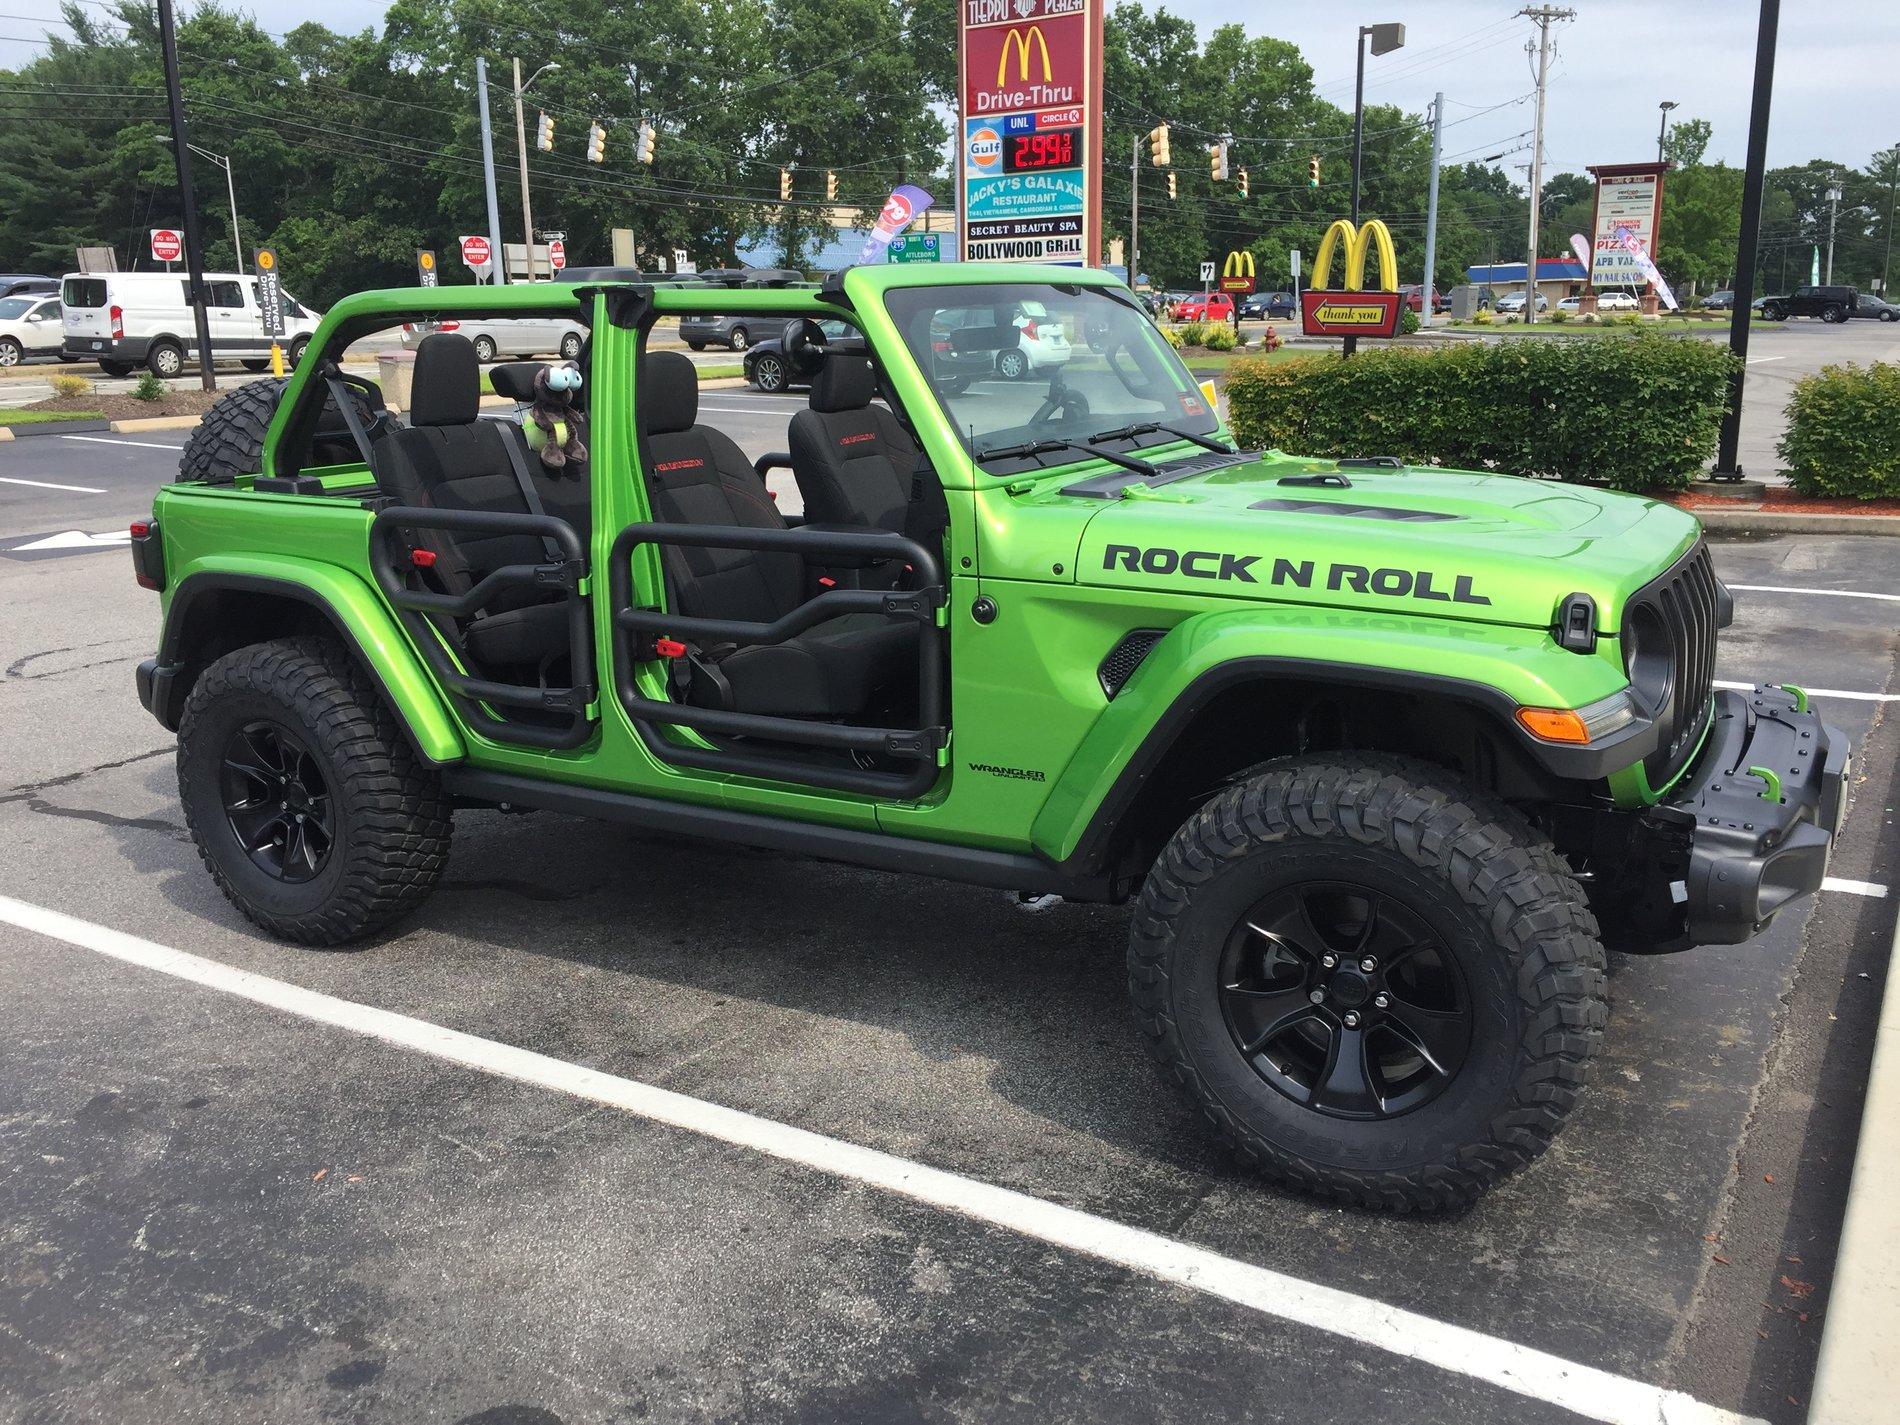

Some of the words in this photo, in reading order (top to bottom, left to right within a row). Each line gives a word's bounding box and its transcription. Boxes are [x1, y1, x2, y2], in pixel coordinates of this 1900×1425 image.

[977, 85, 1073, 111] Drive-Thru
[1010, 117, 1029, 129] UNL
[1041, 113, 1068, 123] CIRCLE
[1069, 110, 1079, 122] K
[970, 142, 1000, 154] Gulf
[968, 178, 1021, 208] JACKY'S
[1024, 176, 1083, 200] GALAXIE
[993, 193, 1057, 206] RESTAURANT
[970, 226, 1010, 236] SECRET
[1014, 223, 1054, 234] BEAUTY
[1059, 221, 1078, 231] SPA
[968, 241, 1042, 260] BOLLYWOOD
[260, 275, 272, 328] Drive-Thru
[266, 272, 282, 331] Reserved
[1323, 307, 1355, 319] thank
[1356, 312, 1377, 323] you
[1102, 543, 1264, 584] ROCK
[1271, 558, 1316, 588] N
[1326, 563, 1493, 606] ROLL
[968, 762, 1046, 779] WRANGLER
[992, 771, 1046, 783] UNLIMITED
